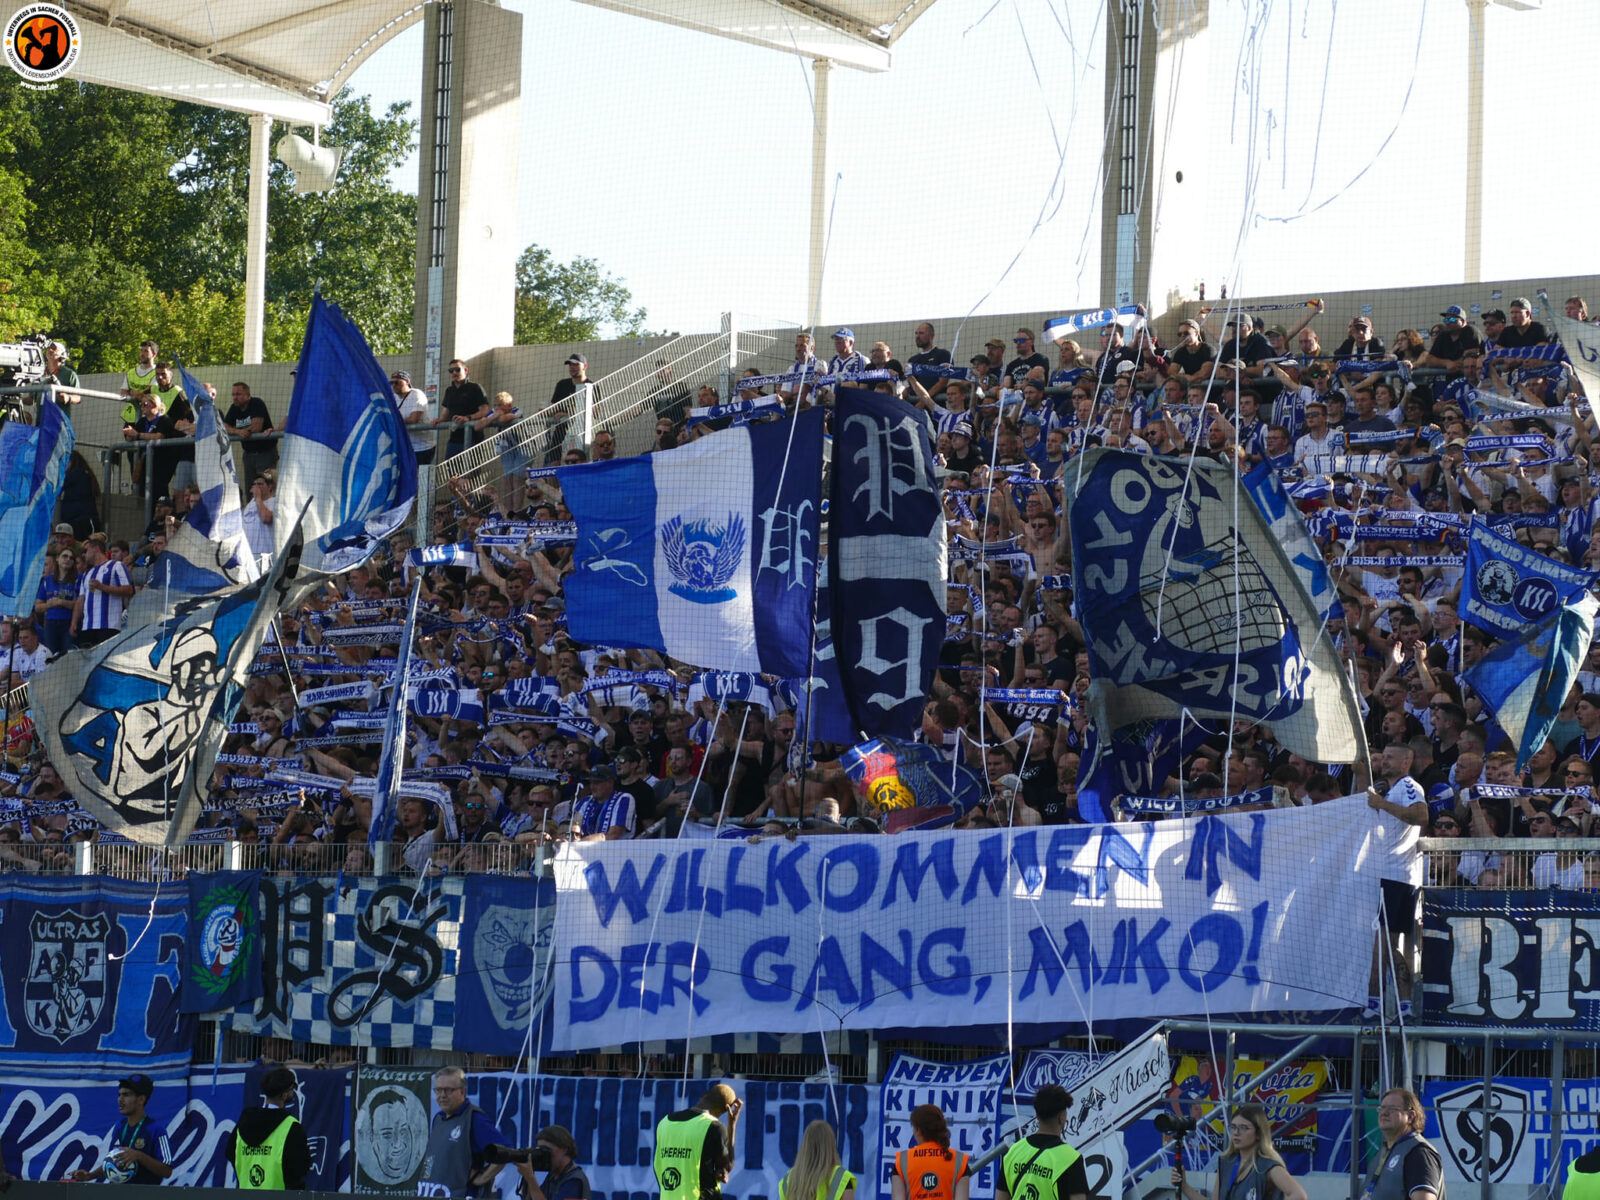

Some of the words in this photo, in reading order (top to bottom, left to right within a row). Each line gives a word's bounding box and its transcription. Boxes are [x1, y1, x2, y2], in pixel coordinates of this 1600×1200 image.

[1082, 310, 1105, 327] KSC
[422, 545, 446, 562] KSC
[1472, 527, 1525, 564] PROUD
[1523, 555, 1592, 586] FANATICS
[1520, 584, 1554, 612] KSC
[583, 822, 1155, 928] WILLKOMMEN
[1184, 813, 1266, 898] IN
[36, 920, 101, 940] ULTRAS
[569, 941, 712, 1025] DER
[741, 927, 992, 1011] GANG,
[1018, 900, 1269, 1002] MIKO!
[893, 1058, 1010, 1084] NERVEN
[886, 1088, 996, 1113] KLINIK
[885, 1126, 993, 1152] KLS
[913, 1148, 947, 1158] AUFSICH
[923, 1176, 936, 1188] KSC
